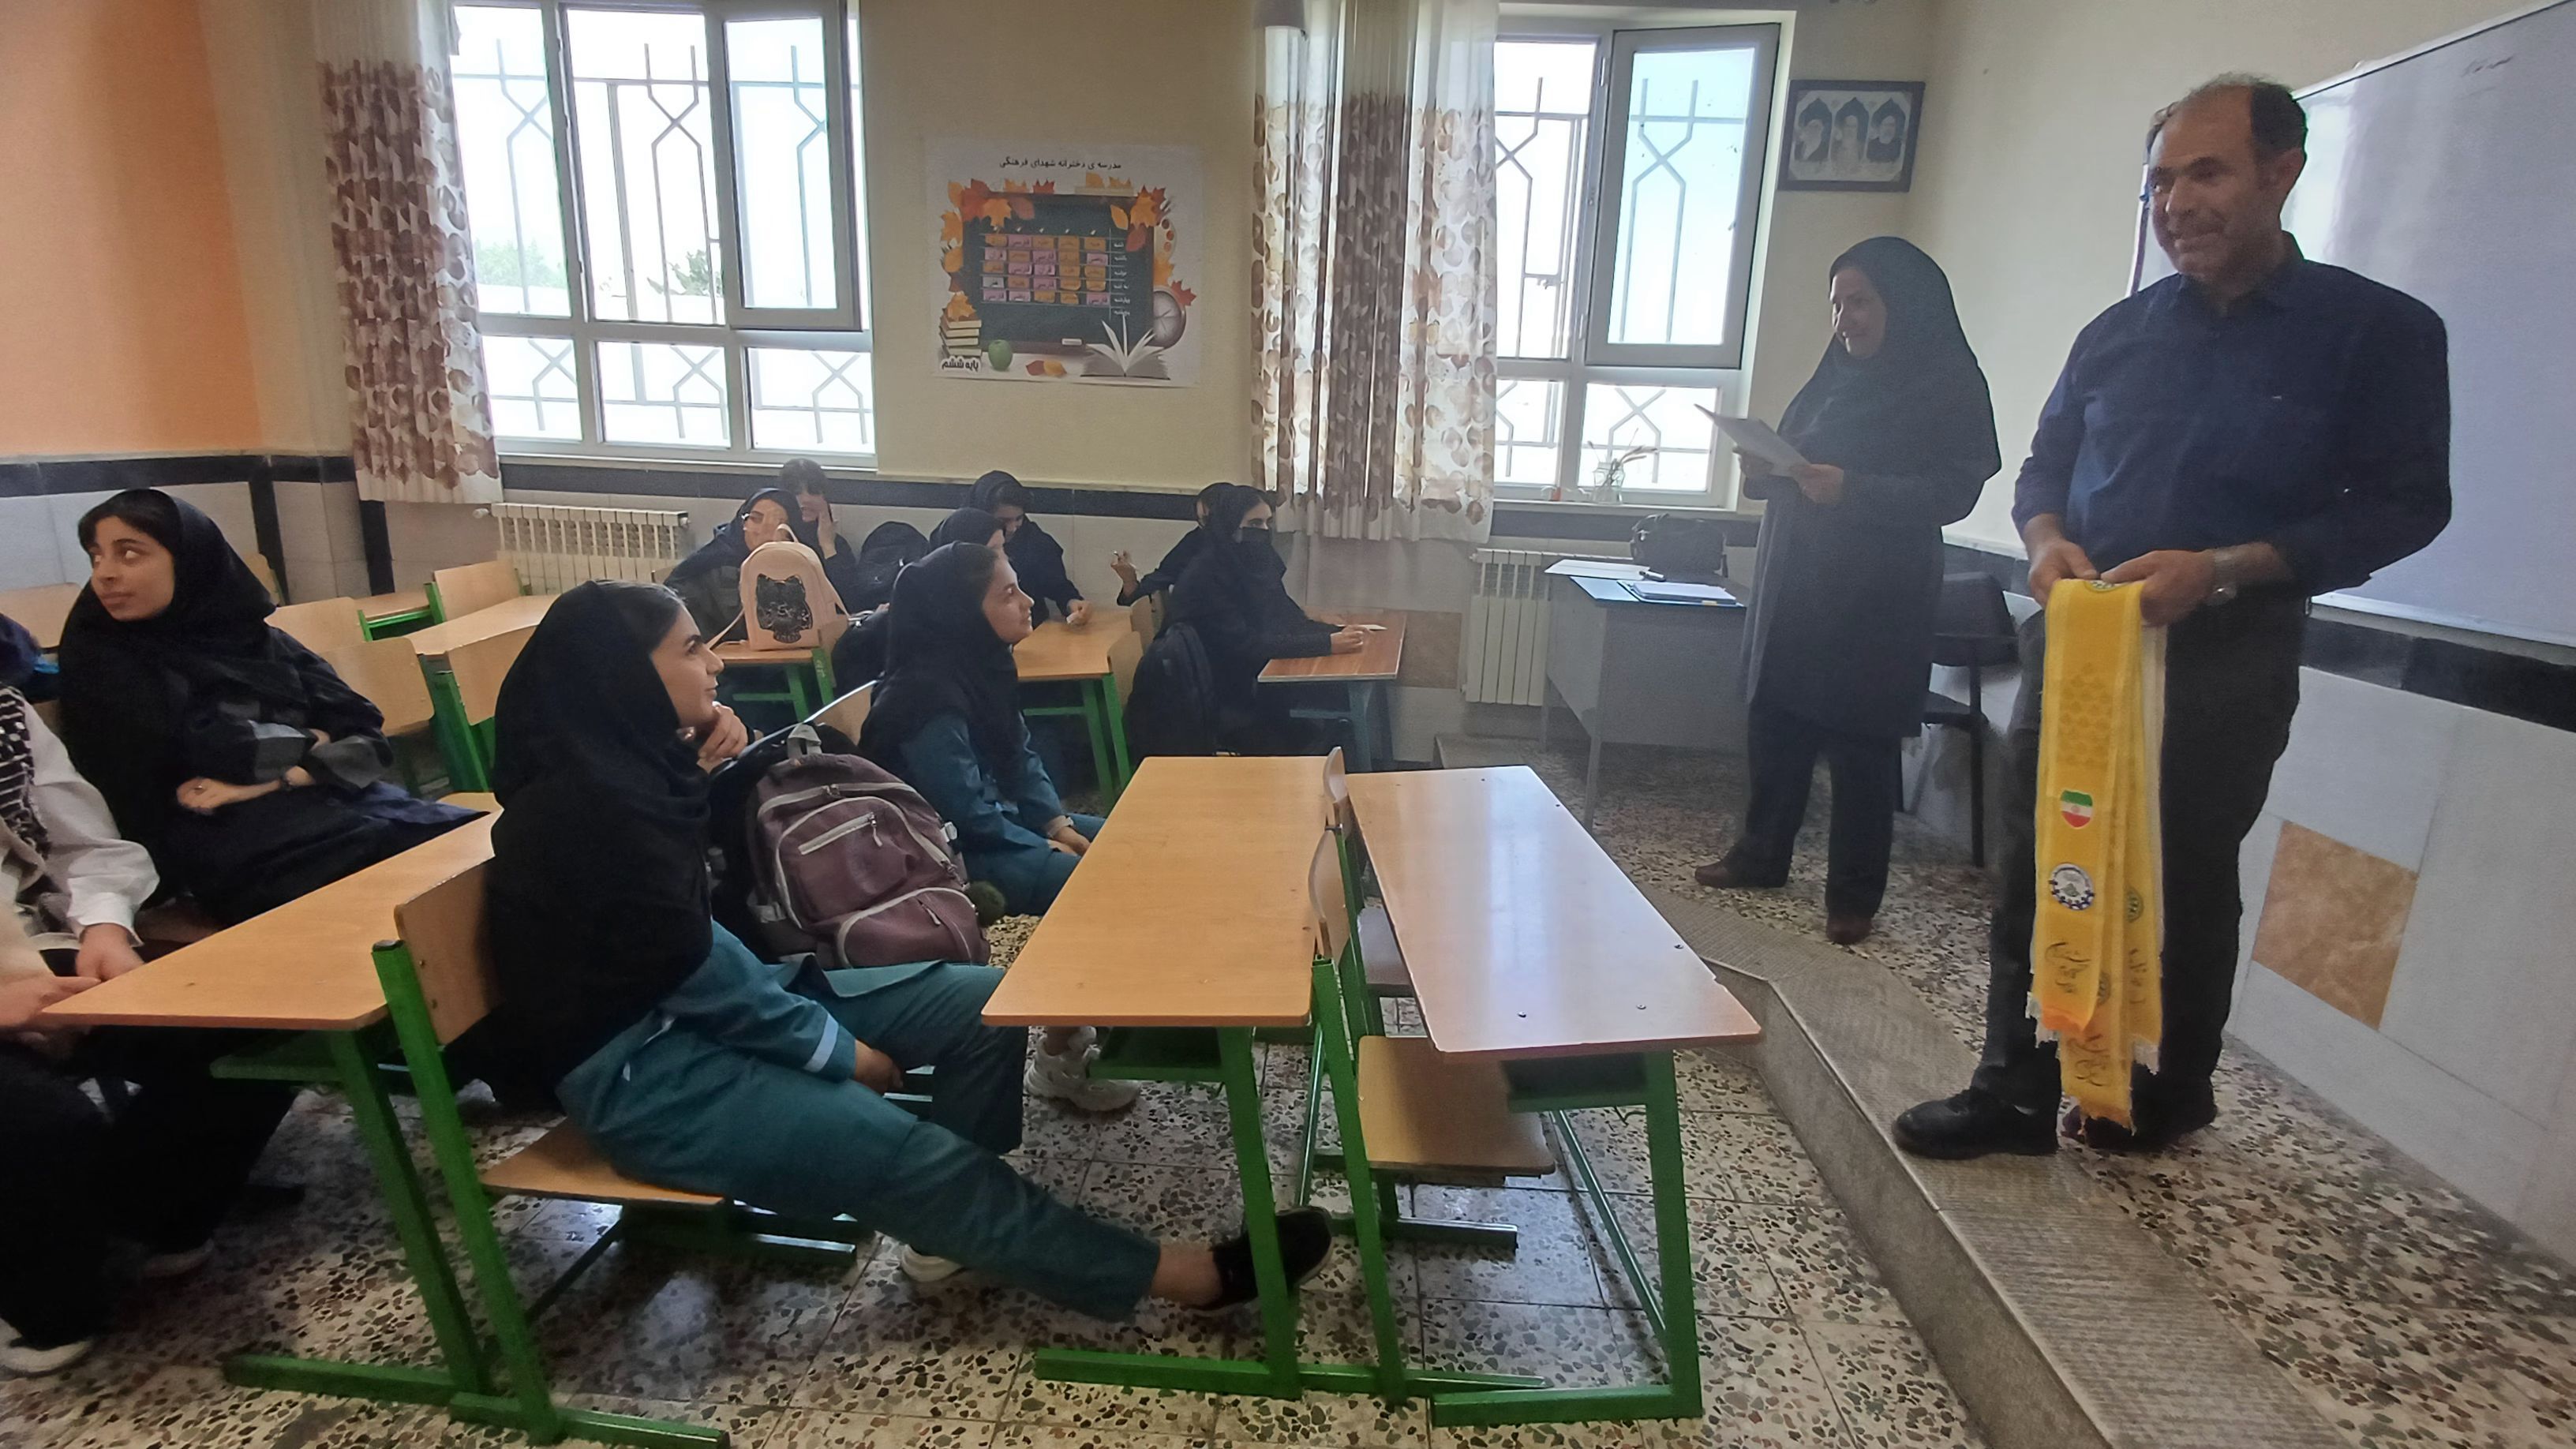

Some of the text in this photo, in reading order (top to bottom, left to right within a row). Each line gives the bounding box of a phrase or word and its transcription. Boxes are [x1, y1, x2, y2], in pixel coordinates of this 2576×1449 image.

[999, 155, 1028, 169] فرهنگی
[1030, 158, 1056, 169] شهدای
[1058, 159, 1085, 170] دخترانه
[942, 358, 979, 373] پایه ششم
